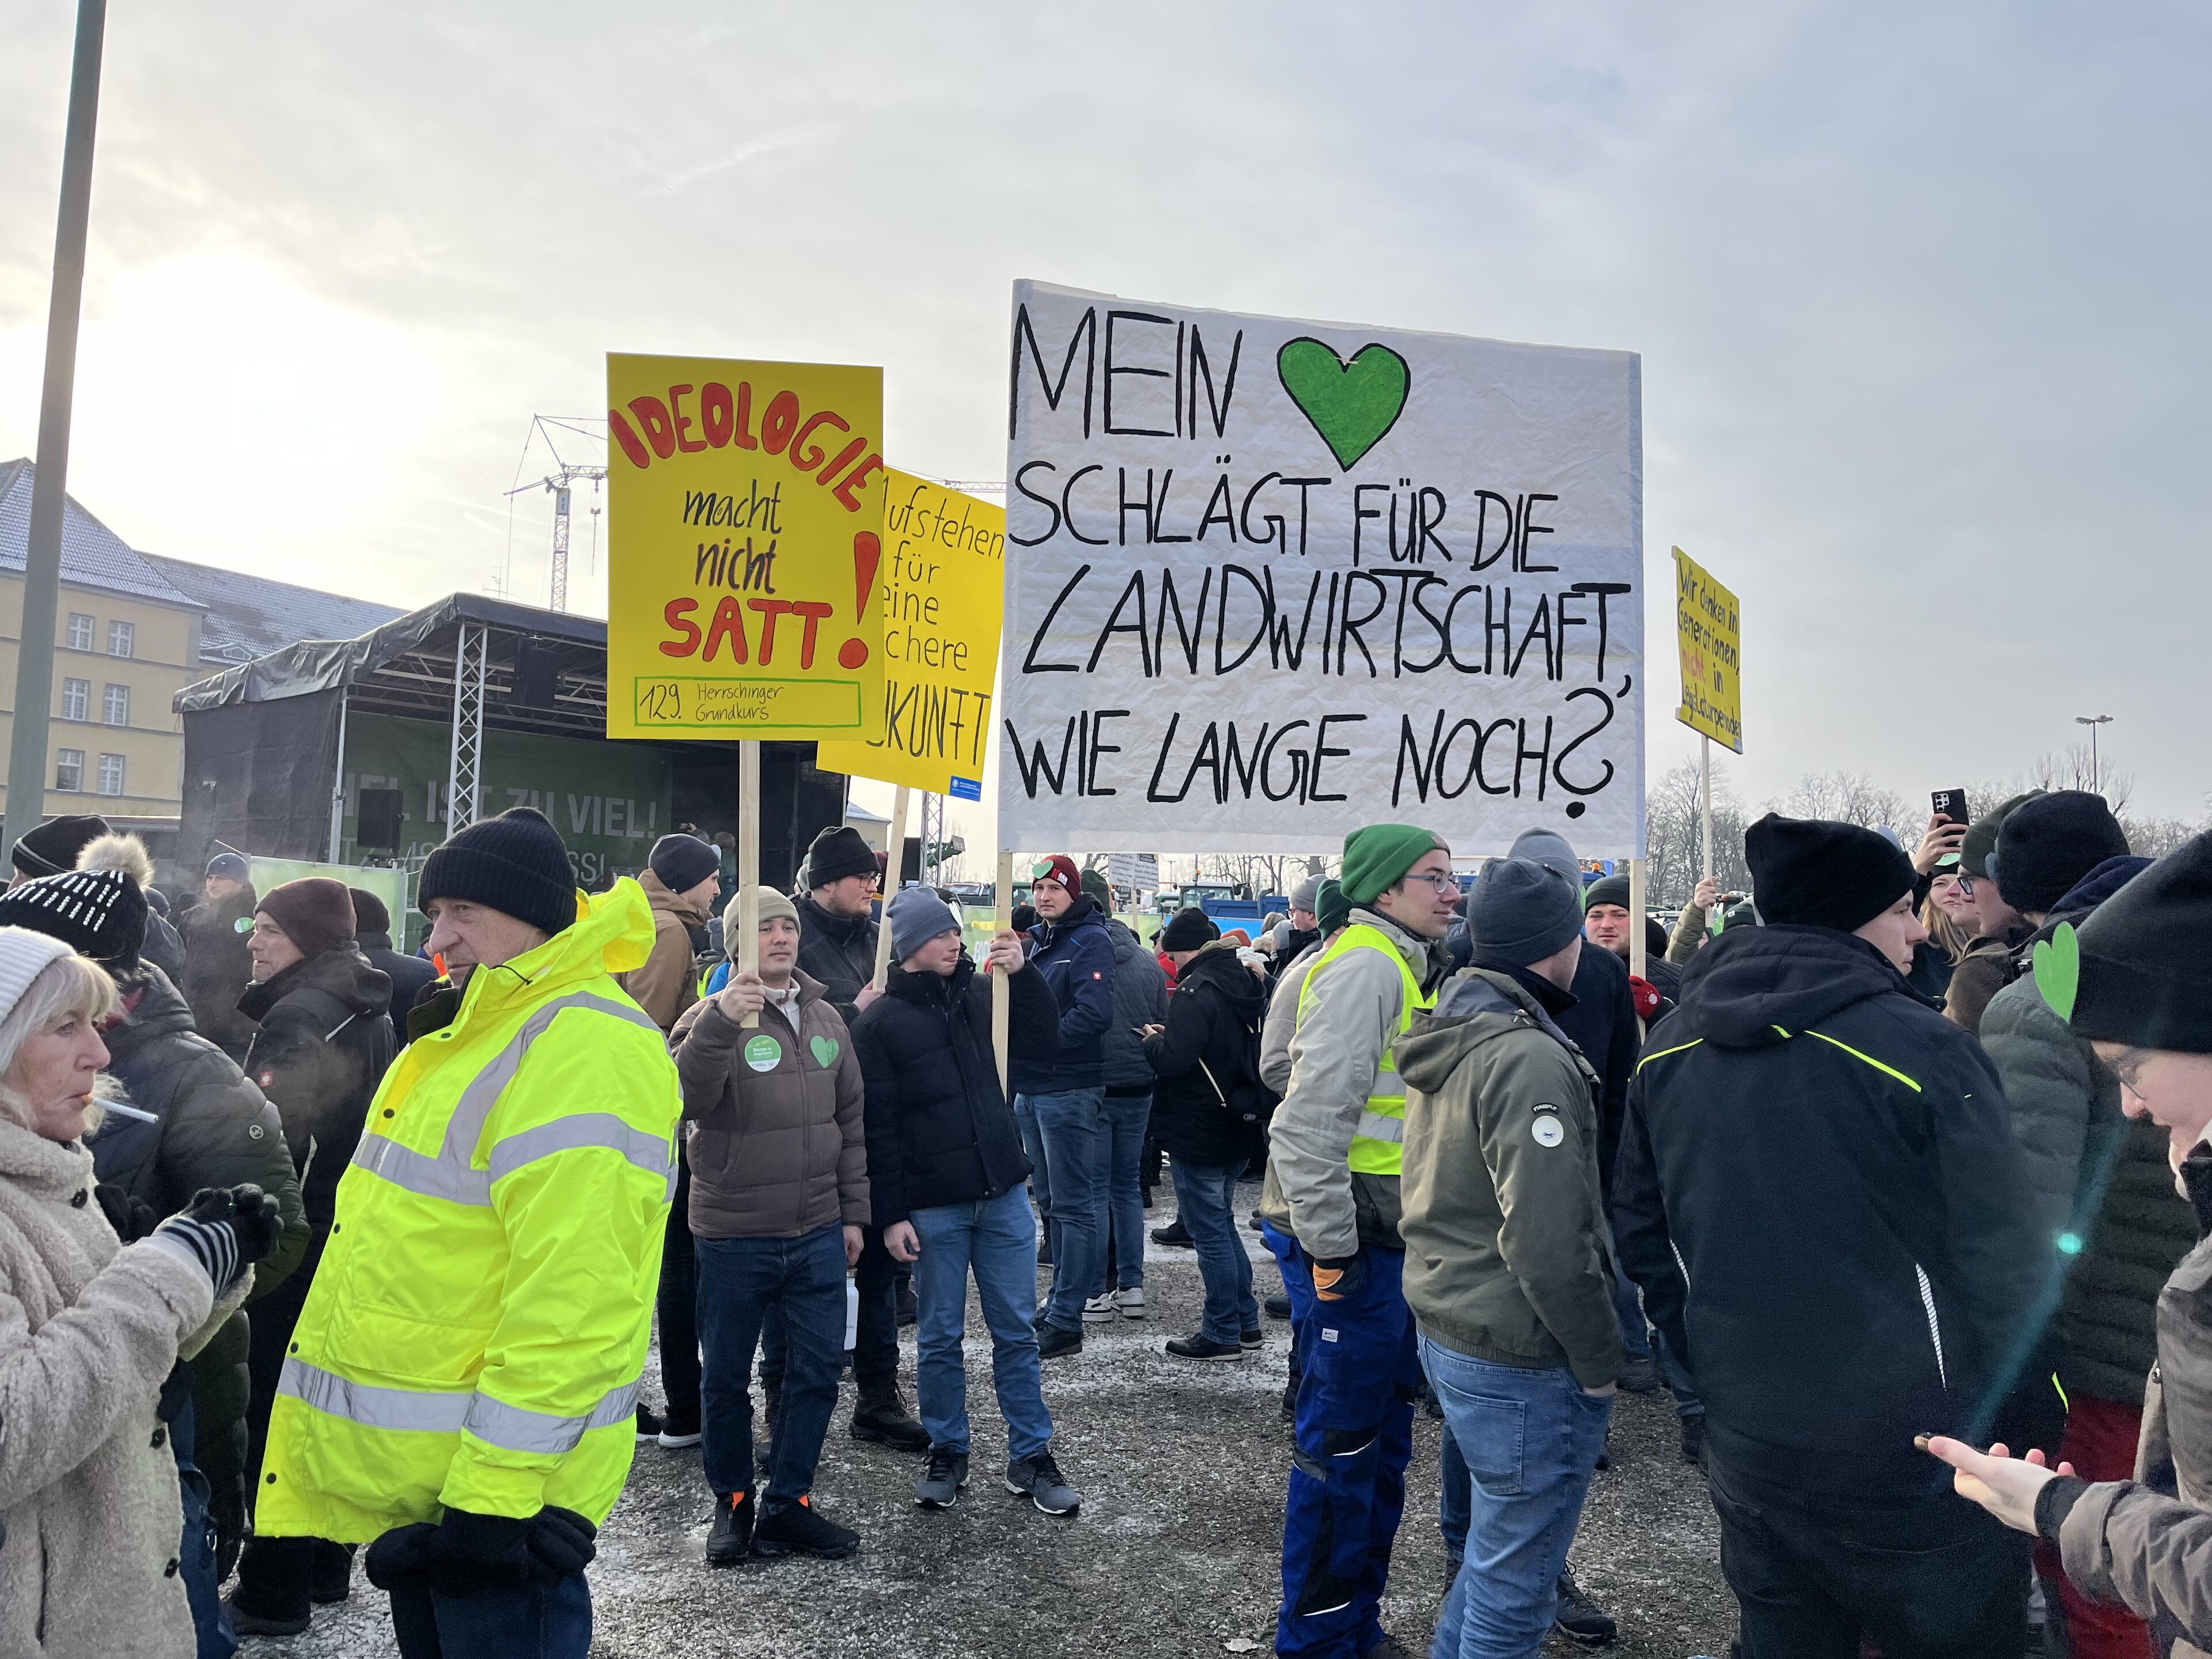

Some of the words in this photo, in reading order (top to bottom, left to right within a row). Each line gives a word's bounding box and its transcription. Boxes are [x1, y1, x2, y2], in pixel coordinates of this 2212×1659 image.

[1010, 303, 1243, 440] MEIN
[608, 382, 883, 512] IDEOLOGIE
[683, 479, 782, 533] macht
[1009, 456, 1331, 555] SCHLÄGT
[1354, 479, 1452, 566] FÜR
[1471, 490, 1559, 573] DIE
[695, 537, 777, 594] nicht
[893, 540, 941, 584] für
[1679, 558, 1698, 602] Wir
[1700, 578, 1725, 627] denken
[1729, 602, 1737, 635] in
[885, 626, 967, 671] chere
[1022, 564, 1631, 698] LANDWIRTSCHAFT,
[1677, 596, 1740, 675] Generationen,
[639, 684, 681, 719] 129.
[697, 682, 785, 704] Herrschinger
[1682, 643, 1706, 684] nicht
[1713, 662, 1723, 695] in
[695, 702, 769, 721] Grundkurs
[865, 680, 990, 766] UKUNFT
[1005, 710, 1130, 799] WIE
[1147, 711, 1368, 805] LANGE
[1392, 688, 1615, 819] NOCH?
[567, 794, 656, 838] VIEL!
